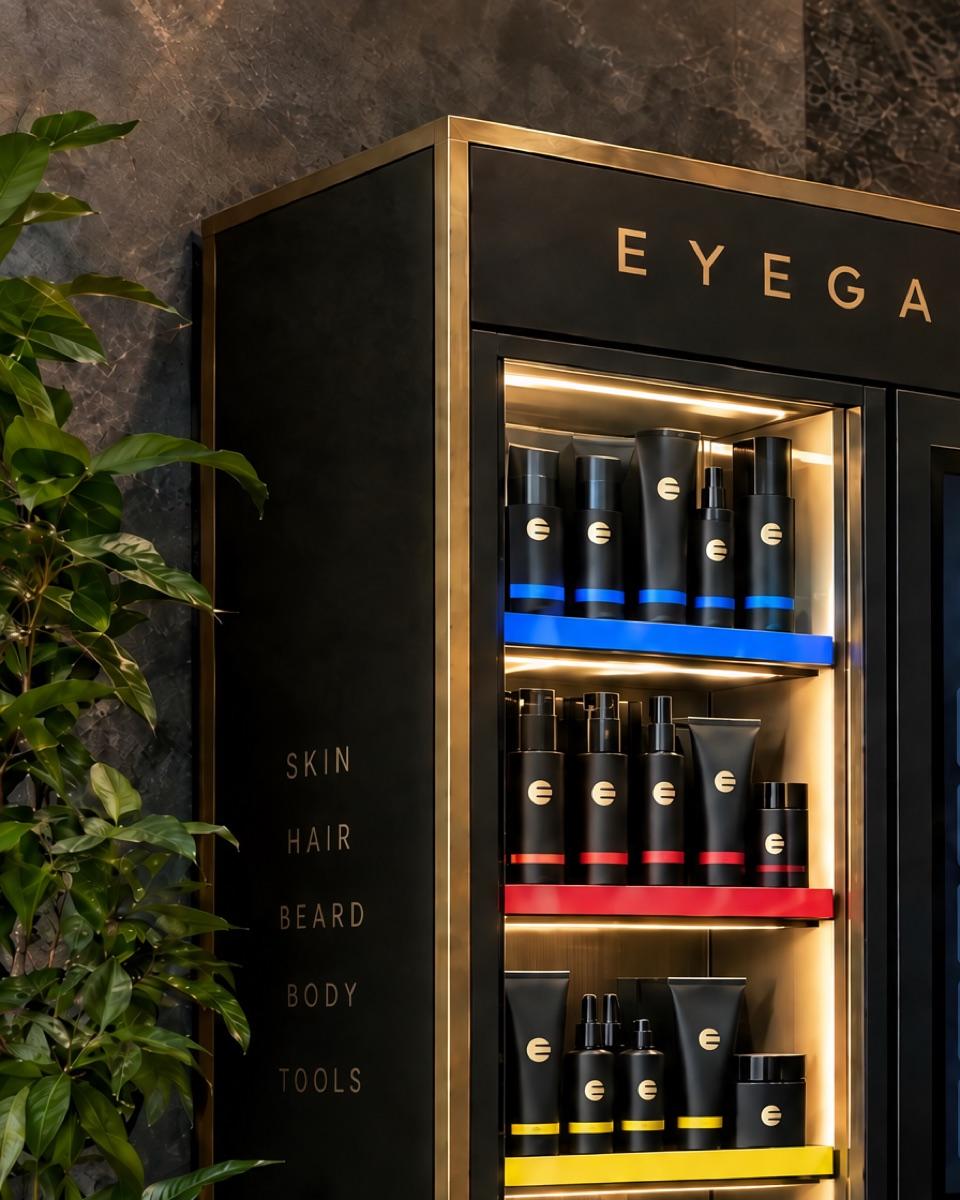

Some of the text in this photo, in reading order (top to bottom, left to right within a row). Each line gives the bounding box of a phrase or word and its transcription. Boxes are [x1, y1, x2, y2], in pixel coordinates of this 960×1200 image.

[285, 745, 350, 780] SKIN
[287, 823, 351, 854] HAIR
[279, 901, 365, 930] BEARD
[286, 981, 358, 1008] BODY
[278, 1067, 362, 1094] TOOLS
